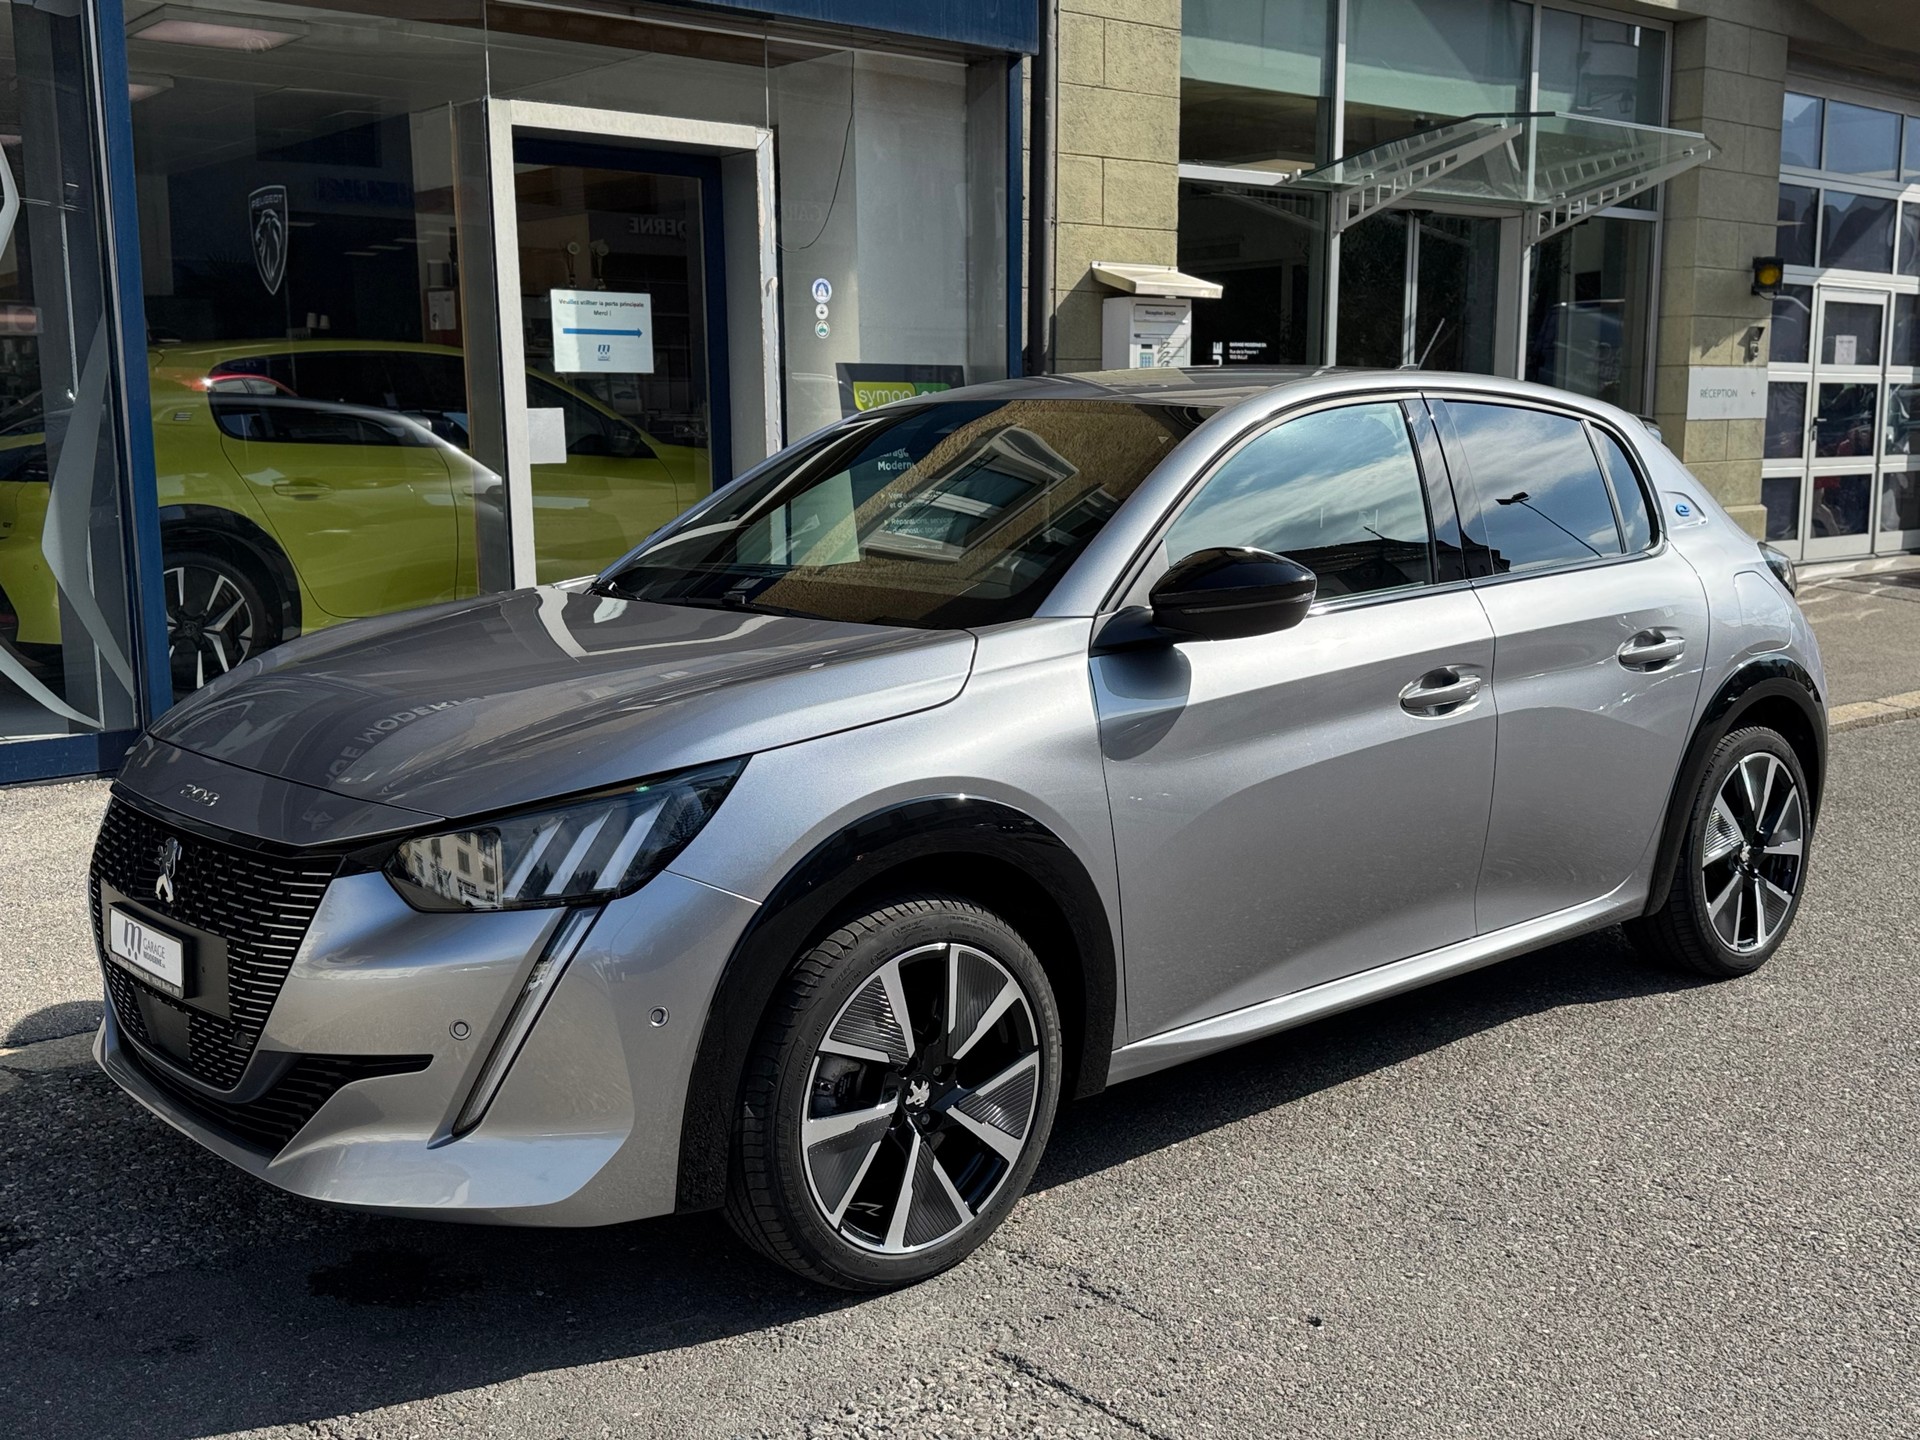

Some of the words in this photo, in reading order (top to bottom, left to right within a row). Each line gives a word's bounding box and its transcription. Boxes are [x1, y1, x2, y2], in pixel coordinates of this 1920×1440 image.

[251, 194, 283, 208] PEUGEOT
[1700, 387, 1738, 399] RÉCEPTION
[180, 784, 220, 807] 208
[143, 938, 166, 960] GARAGE
